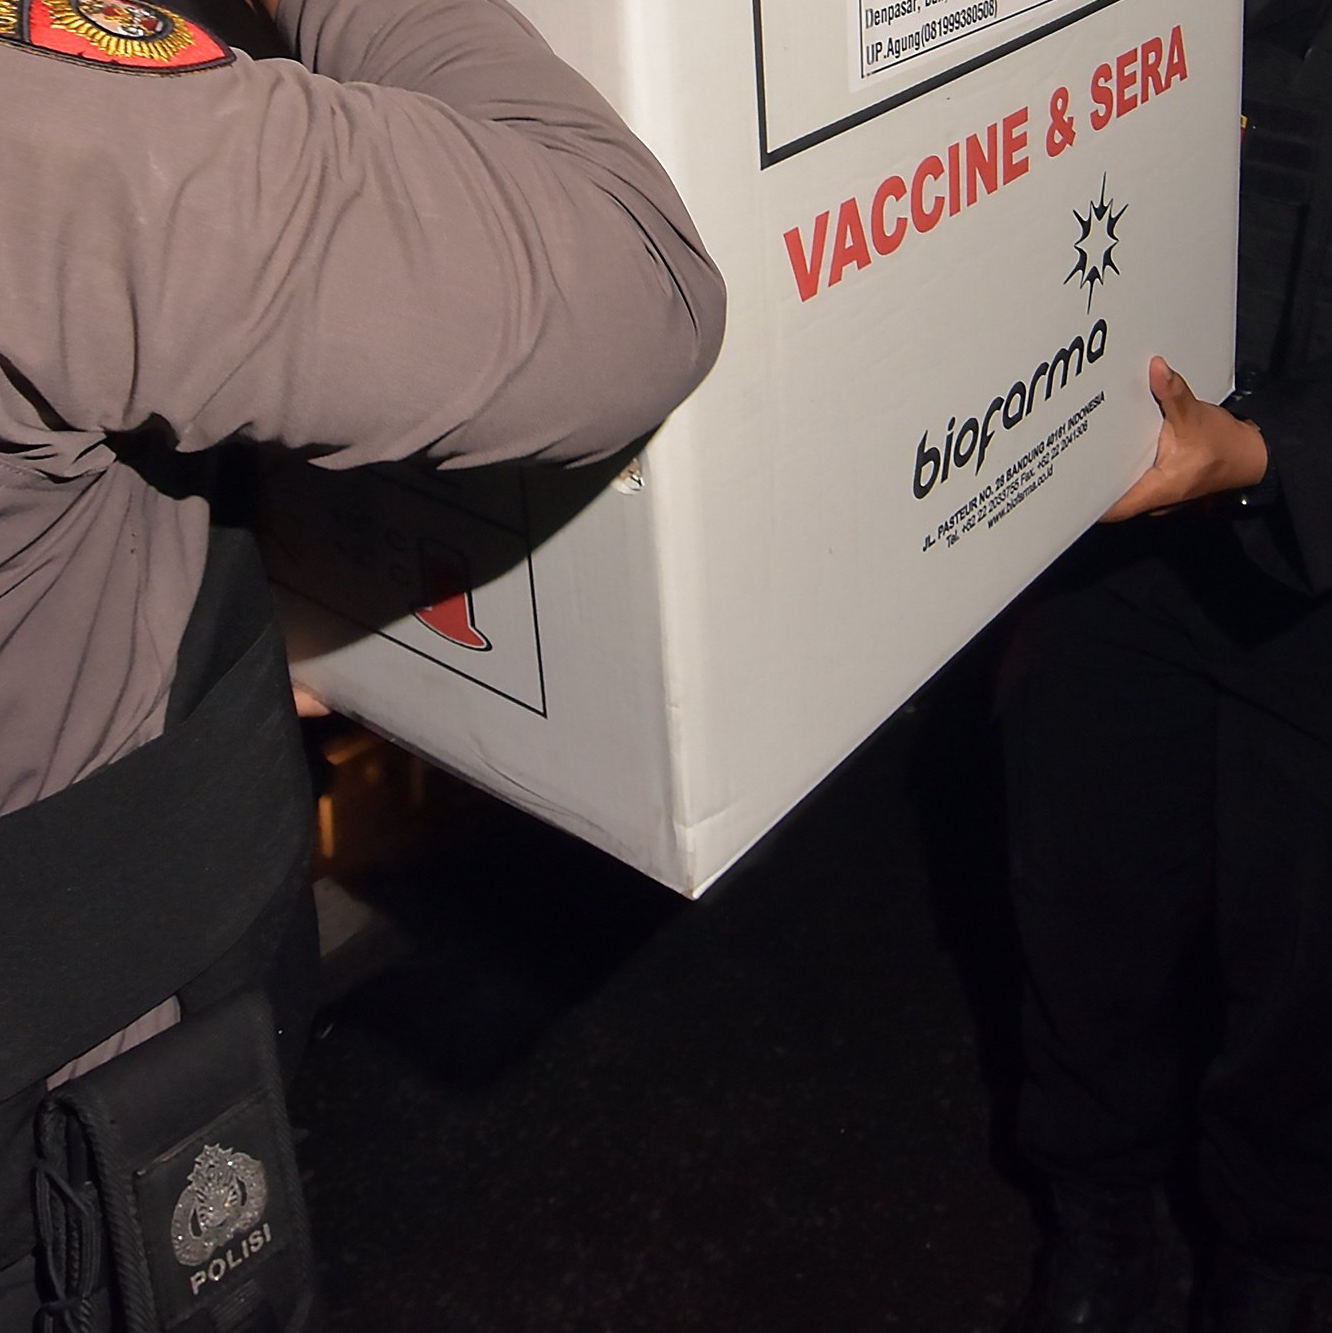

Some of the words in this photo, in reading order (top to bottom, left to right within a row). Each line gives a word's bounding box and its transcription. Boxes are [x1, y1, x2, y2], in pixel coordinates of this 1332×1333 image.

[782, 106, 1030, 302] VACCINE
[1045, 86, 1077, 158] &
[1089, 25, 1188, 131] SERA
[912, 318, 1108, 500] biofarma
[937, 496, 978, 539] PASTEUR
[978, 485, 994, 505] NO.
[1006, 441, 1045, 482] BANDUNG
[1067, 390, 1105, 431] INDONESIA
[189, 1222, 272, 1296] POLISI
